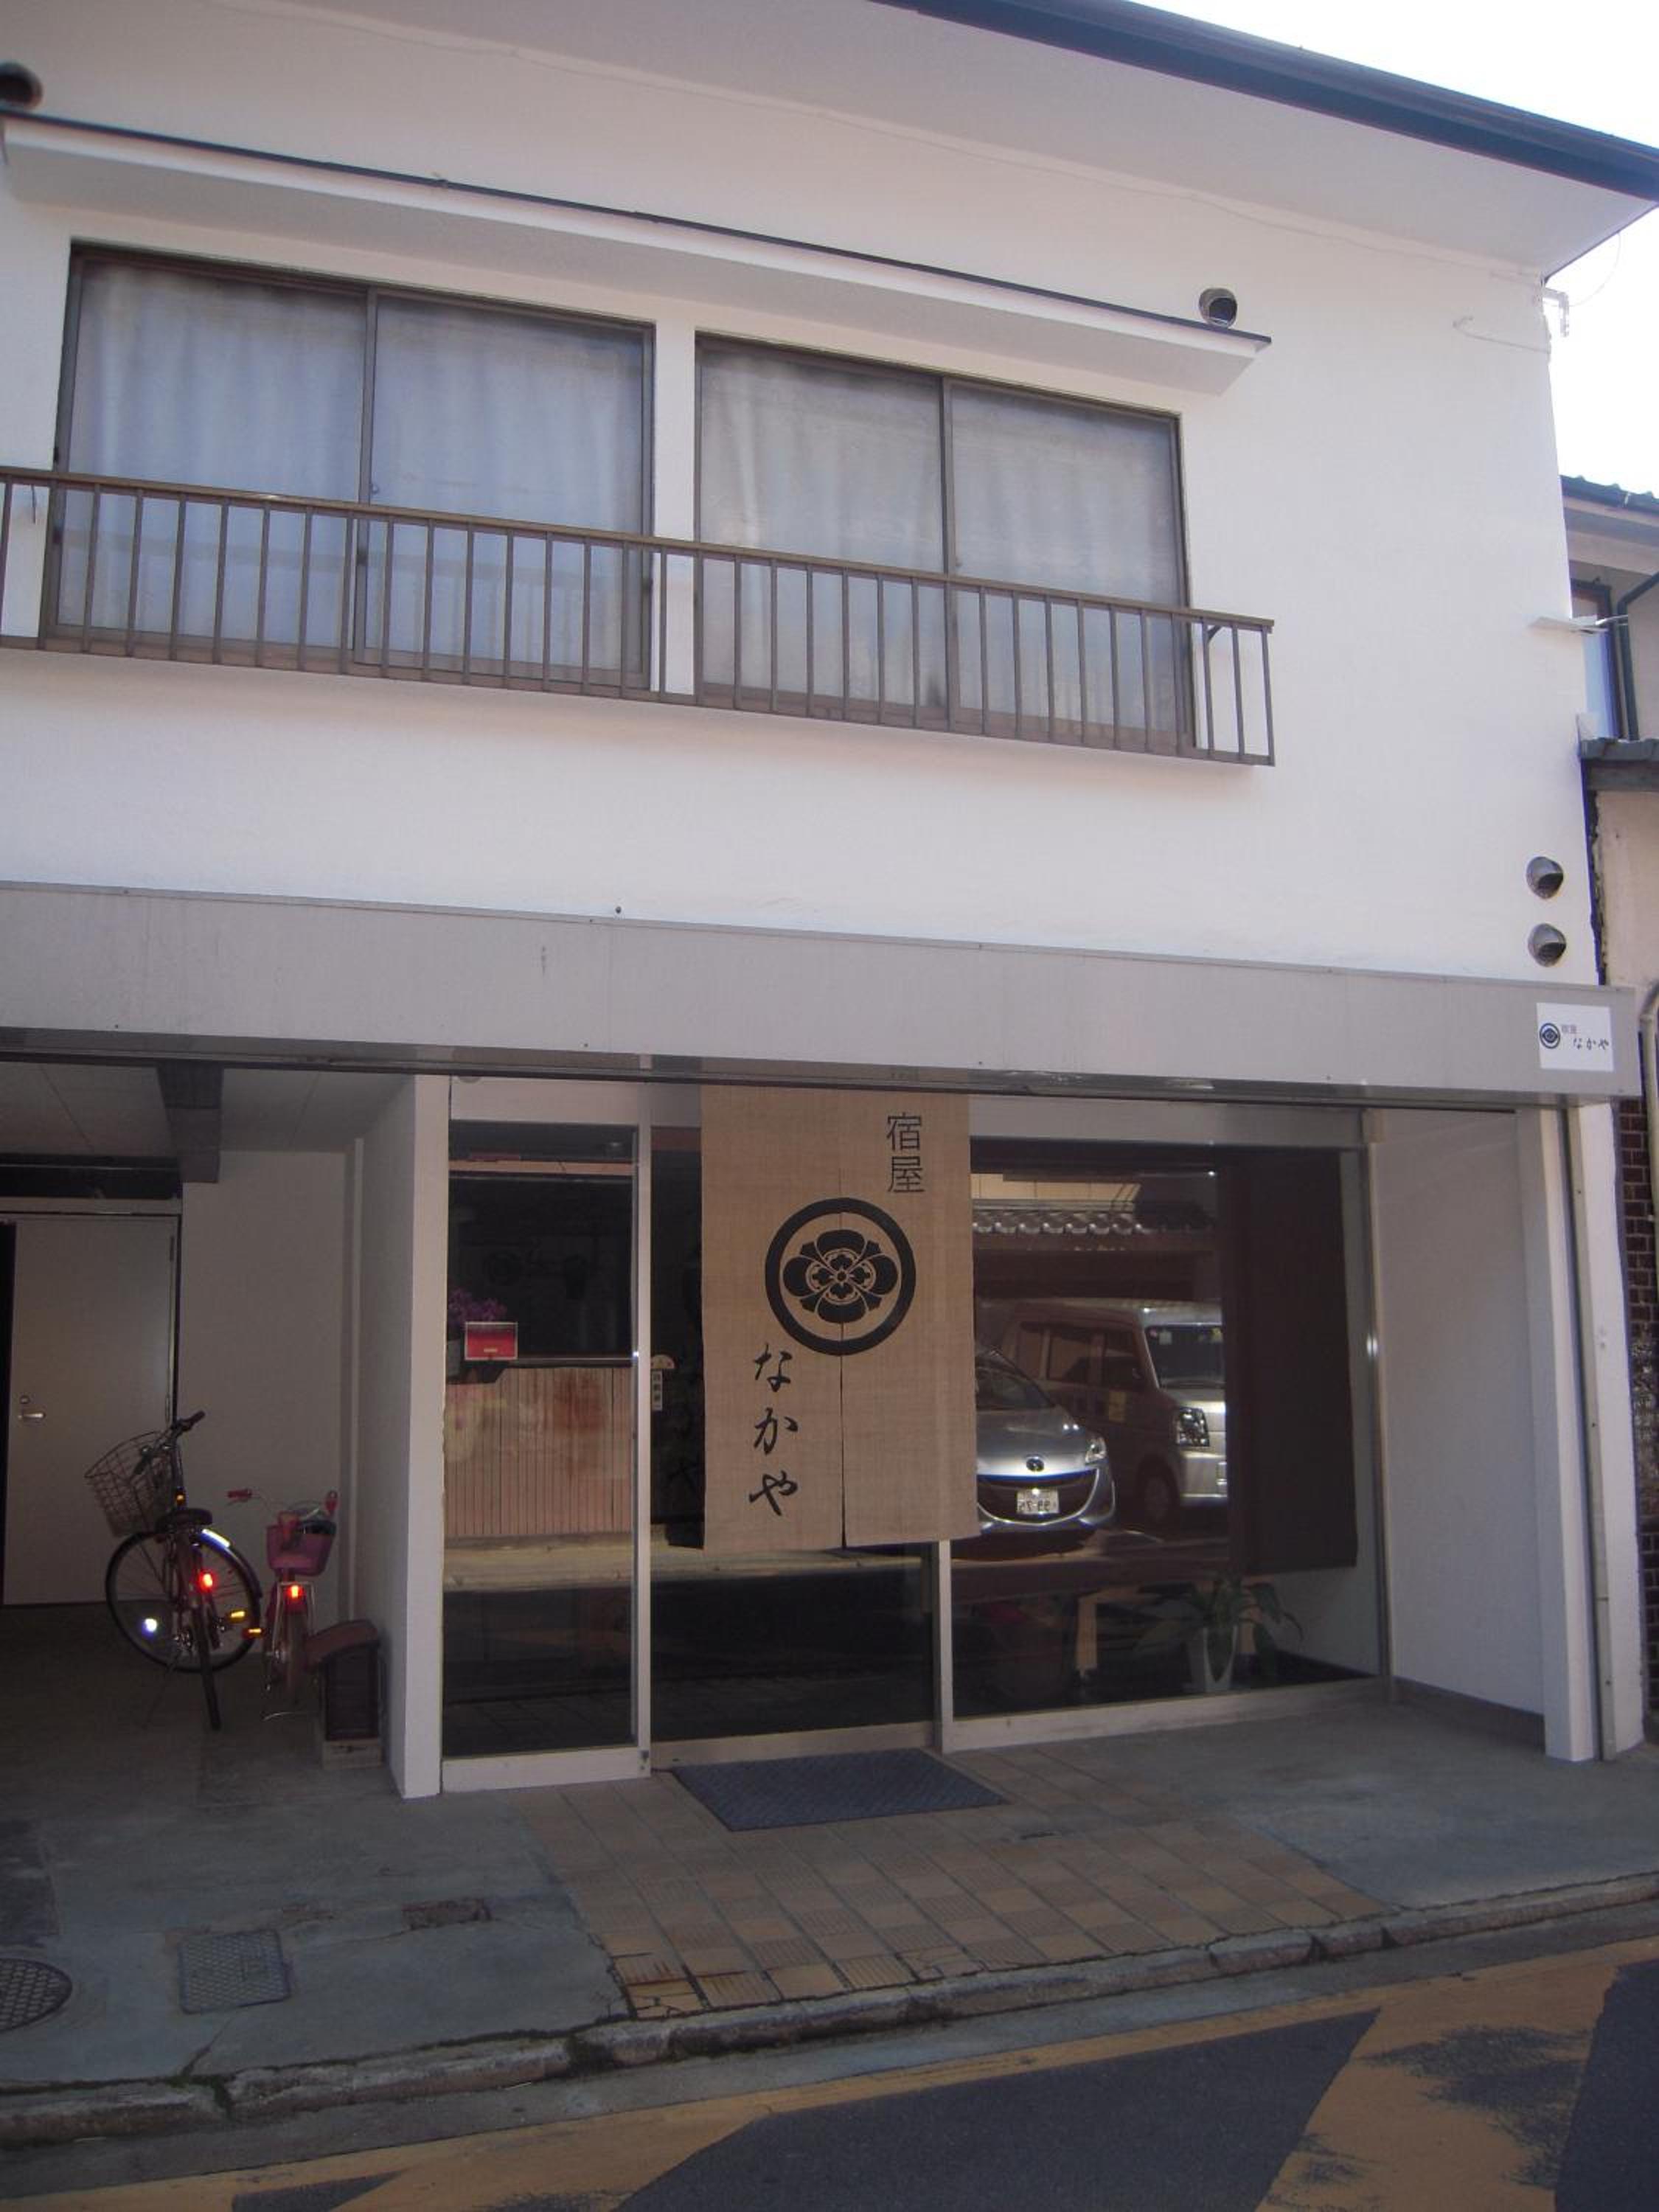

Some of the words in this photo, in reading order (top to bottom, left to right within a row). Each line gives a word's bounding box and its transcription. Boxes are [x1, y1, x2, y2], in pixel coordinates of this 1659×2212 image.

[886, 1112, 925, 1194] 宿屋
[748, 1343, 798, 1516] なかや
